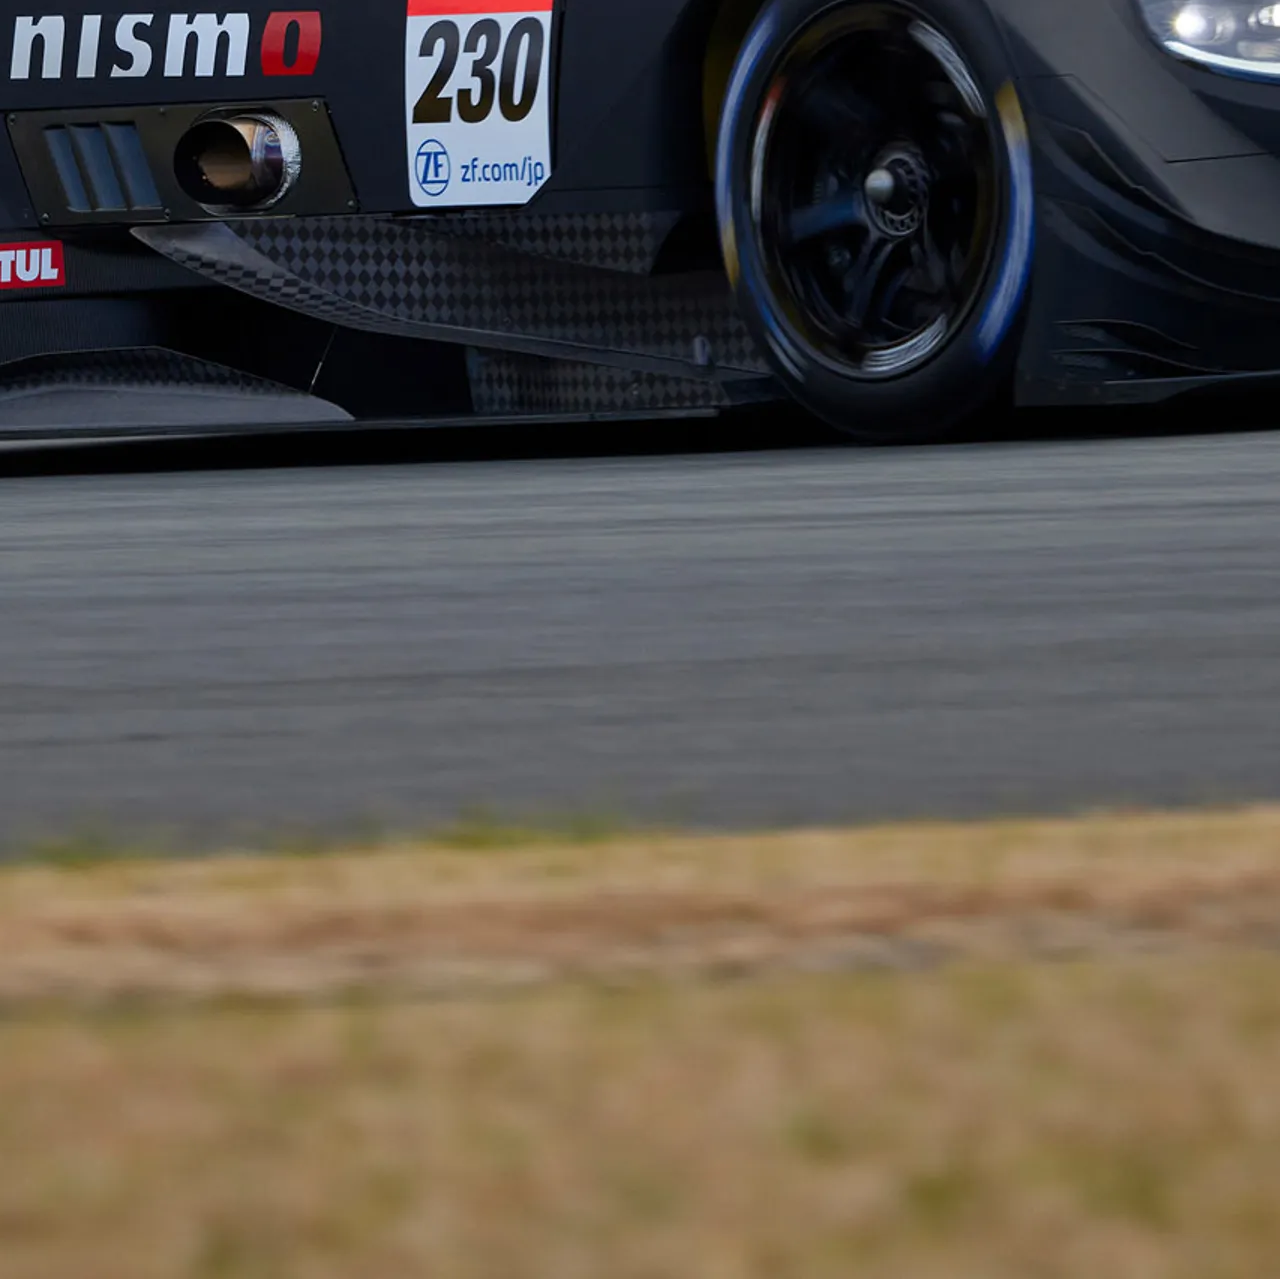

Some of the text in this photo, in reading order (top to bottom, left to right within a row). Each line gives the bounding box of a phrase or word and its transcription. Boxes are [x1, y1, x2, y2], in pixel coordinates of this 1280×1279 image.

[10, 10, 321, 79] nismo
[412, 17, 544, 124] 230
[416, 150, 545, 186] ZF zf.com/jp
